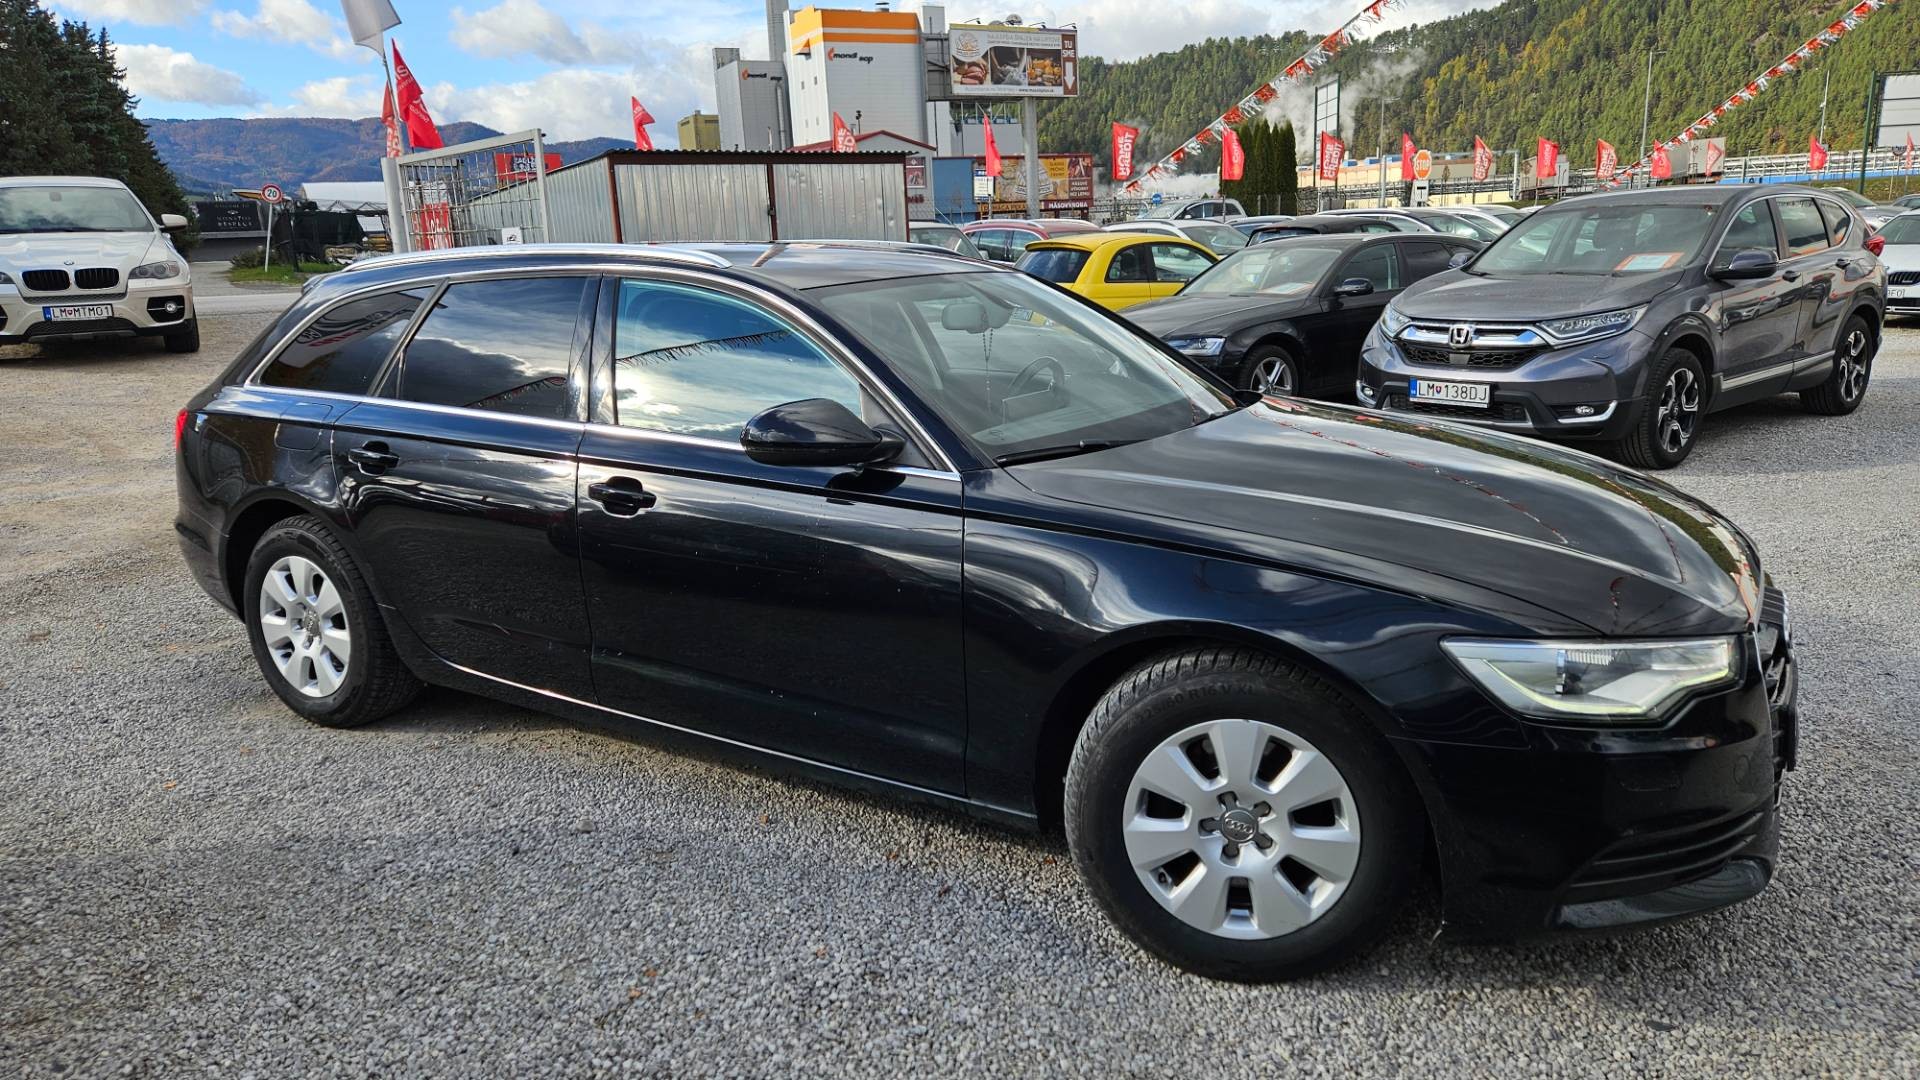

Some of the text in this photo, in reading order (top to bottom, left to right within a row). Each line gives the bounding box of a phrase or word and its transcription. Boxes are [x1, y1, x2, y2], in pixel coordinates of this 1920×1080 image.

[1323, 144, 1333, 177] HOME
[1328, 142, 1343, 178] CREDIT
[1416, 159, 1430, 170] STOP
[267, 190, 277, 198] 20
